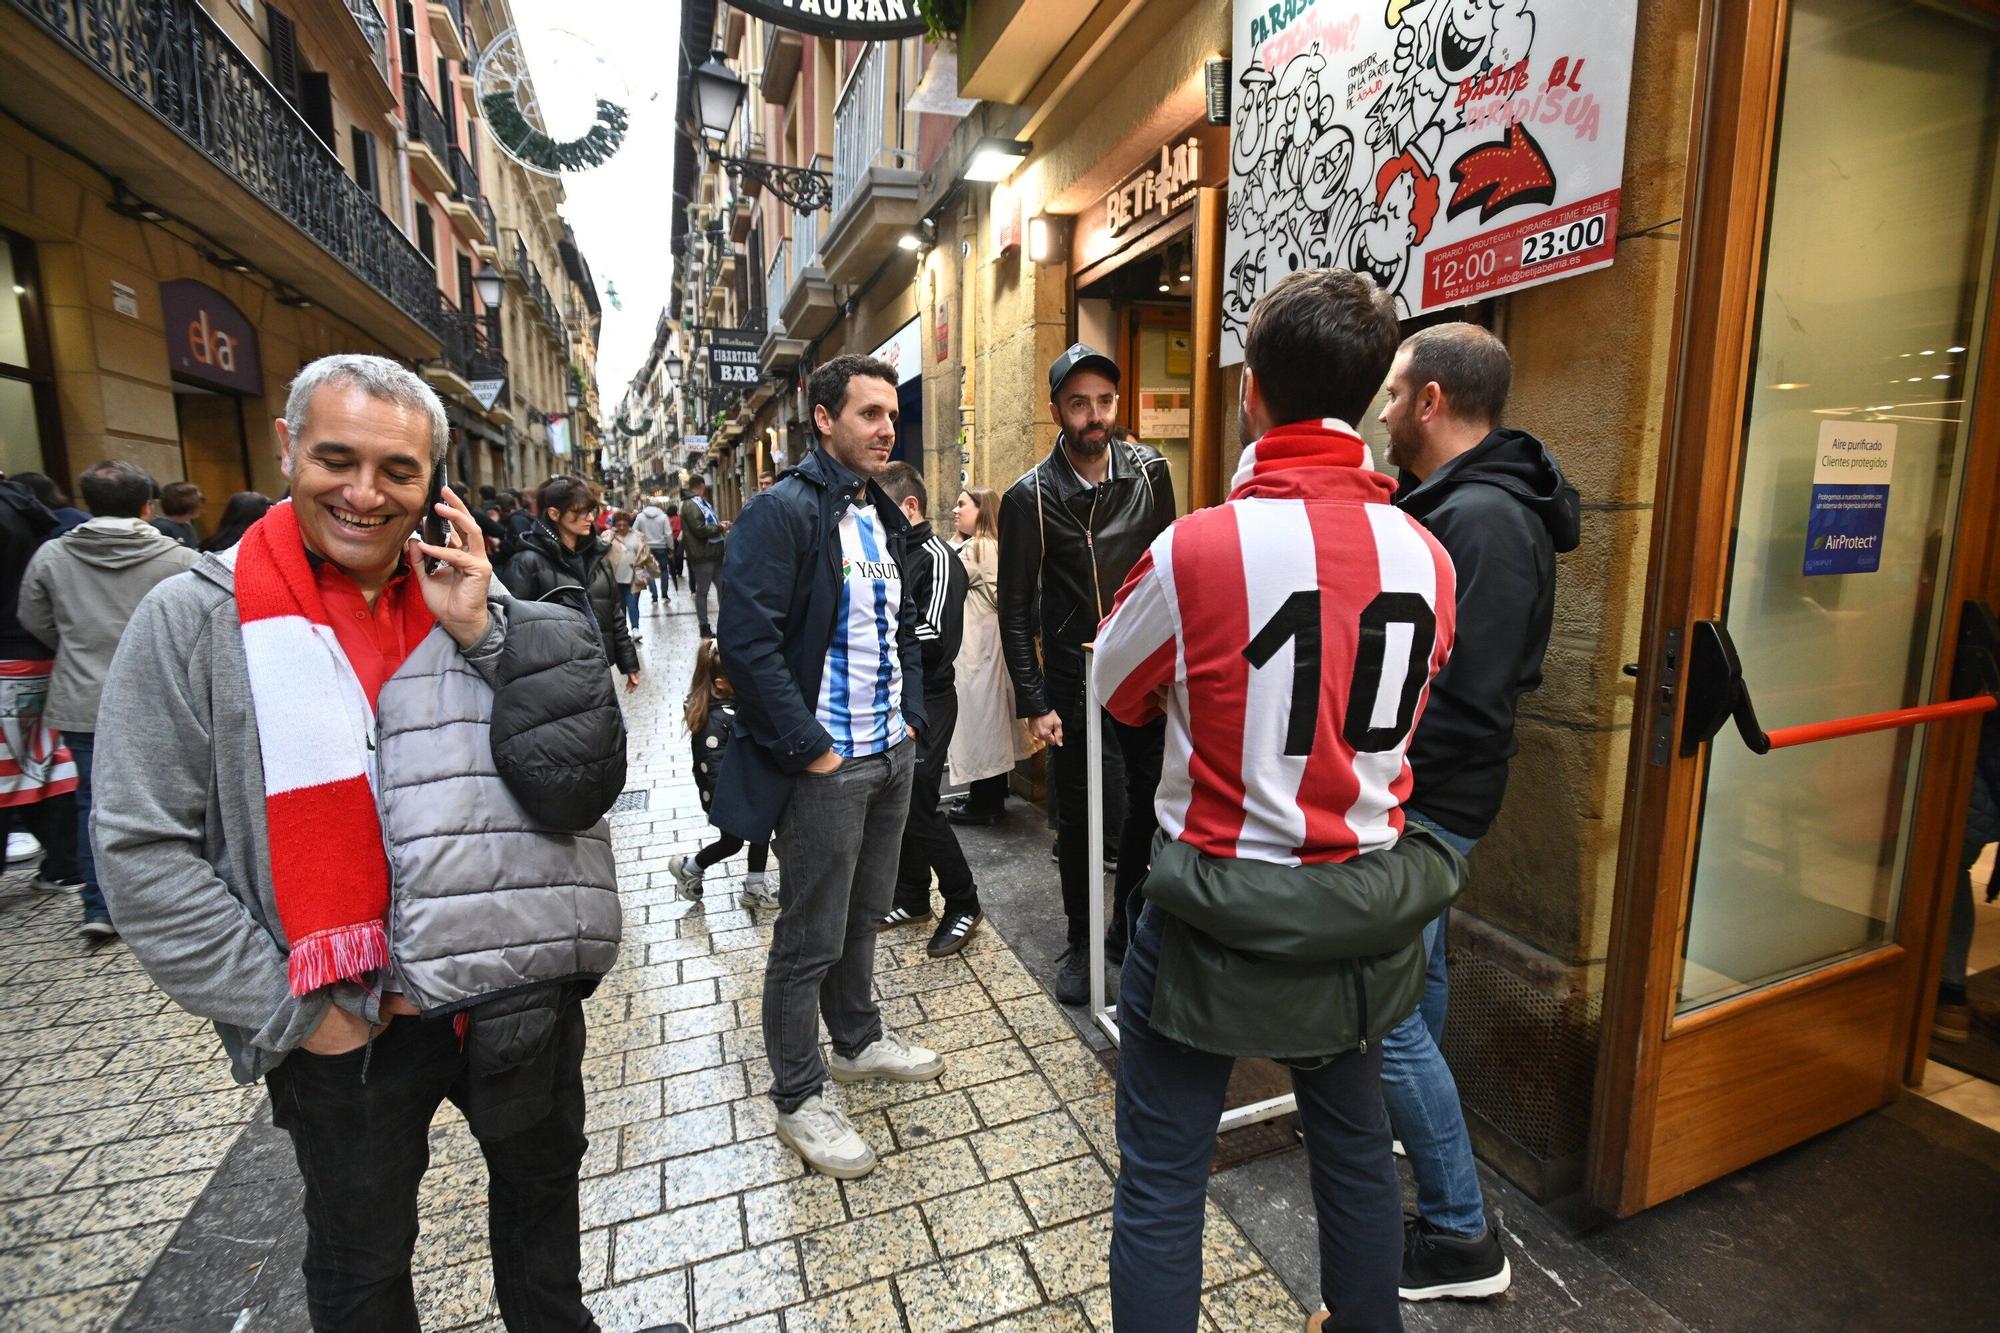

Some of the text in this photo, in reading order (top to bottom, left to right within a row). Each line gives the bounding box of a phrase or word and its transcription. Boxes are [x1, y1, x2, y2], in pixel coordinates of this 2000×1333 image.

[1250, 0, 1316, 47] PARAIS
[1432, 247, 1464, 263] HORARIO
[1468, 231, 1511, 251] ORDUTEGIA
[1516, 217, 1553, 236] HORAIRE
[1559, 208, 1580, 223] TIME
[1582, 198, 1610, 215] TABLE
[1432, 248, 1496, 290] 12:00
[1522, 216, 1604, 265] 23:00
[1445, 287, 1459, 299] 943
[720, 365, 759, 382] BAR
[1832, 438, 1883, 453] Aire purificado
[1821, 455, 1888, 470] Clientes protegidos
[855, 561, 902, 579] YASUD
[1241, 589, 1437, 756] 10
